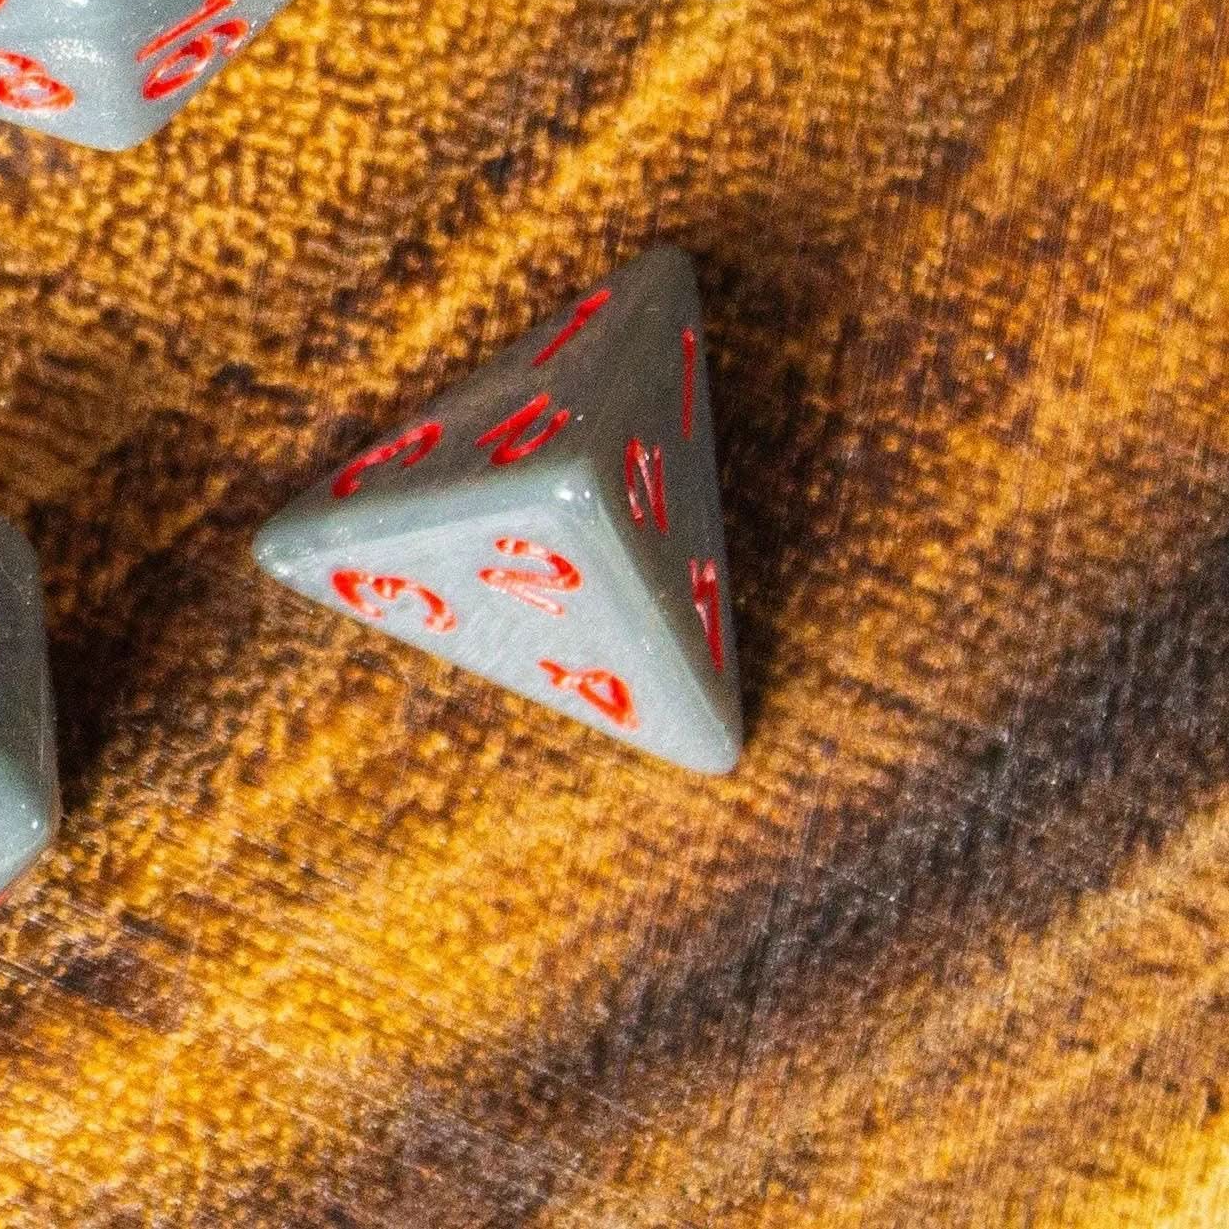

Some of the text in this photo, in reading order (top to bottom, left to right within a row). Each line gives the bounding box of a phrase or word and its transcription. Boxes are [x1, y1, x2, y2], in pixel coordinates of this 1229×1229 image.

[531, 286, 614, 369] 1
[474, 392, 572, 468] 2
[329, 566, 459, 634] 3
[477, 535, 584, 618] 2
[537, 657, 641, 732] 4
